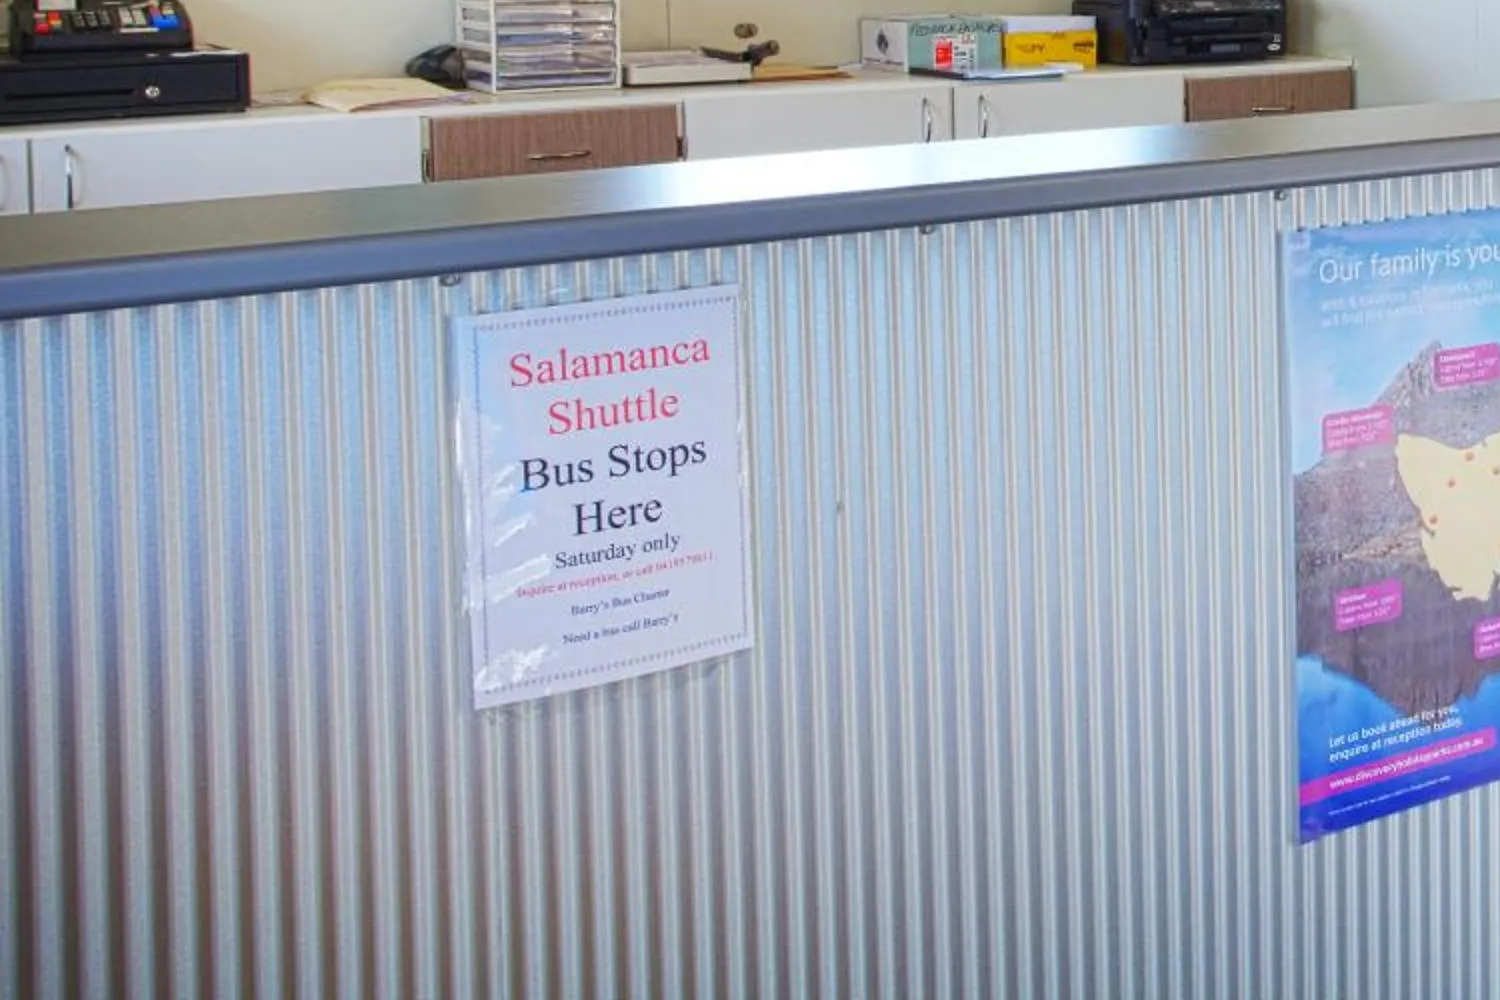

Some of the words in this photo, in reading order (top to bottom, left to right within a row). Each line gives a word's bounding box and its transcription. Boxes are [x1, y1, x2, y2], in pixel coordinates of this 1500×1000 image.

[1319, 258, 1362, 284] Our
[1371, 247, 1440, 278] family
[1445, 243, 1461, 268] is
[509, 338, 711, 388] Salamanca
[549, 387, 680, 436] Shuttle
[521, 456, 595, 494] Bus
[608, 438, 707, 484] Stops
[573, 498, 664, 537] Here
[555, 543, 637, 570] Saturday
[643, 532, 681, 554] only
[1329, 735, 1345, 749] Let
[1361, 723, 1387, 738] book
[1329, 744, 1369, 763] enquire
[1371, 740, 1381, 750] at
[1383, 726, 1431, 746] reception
